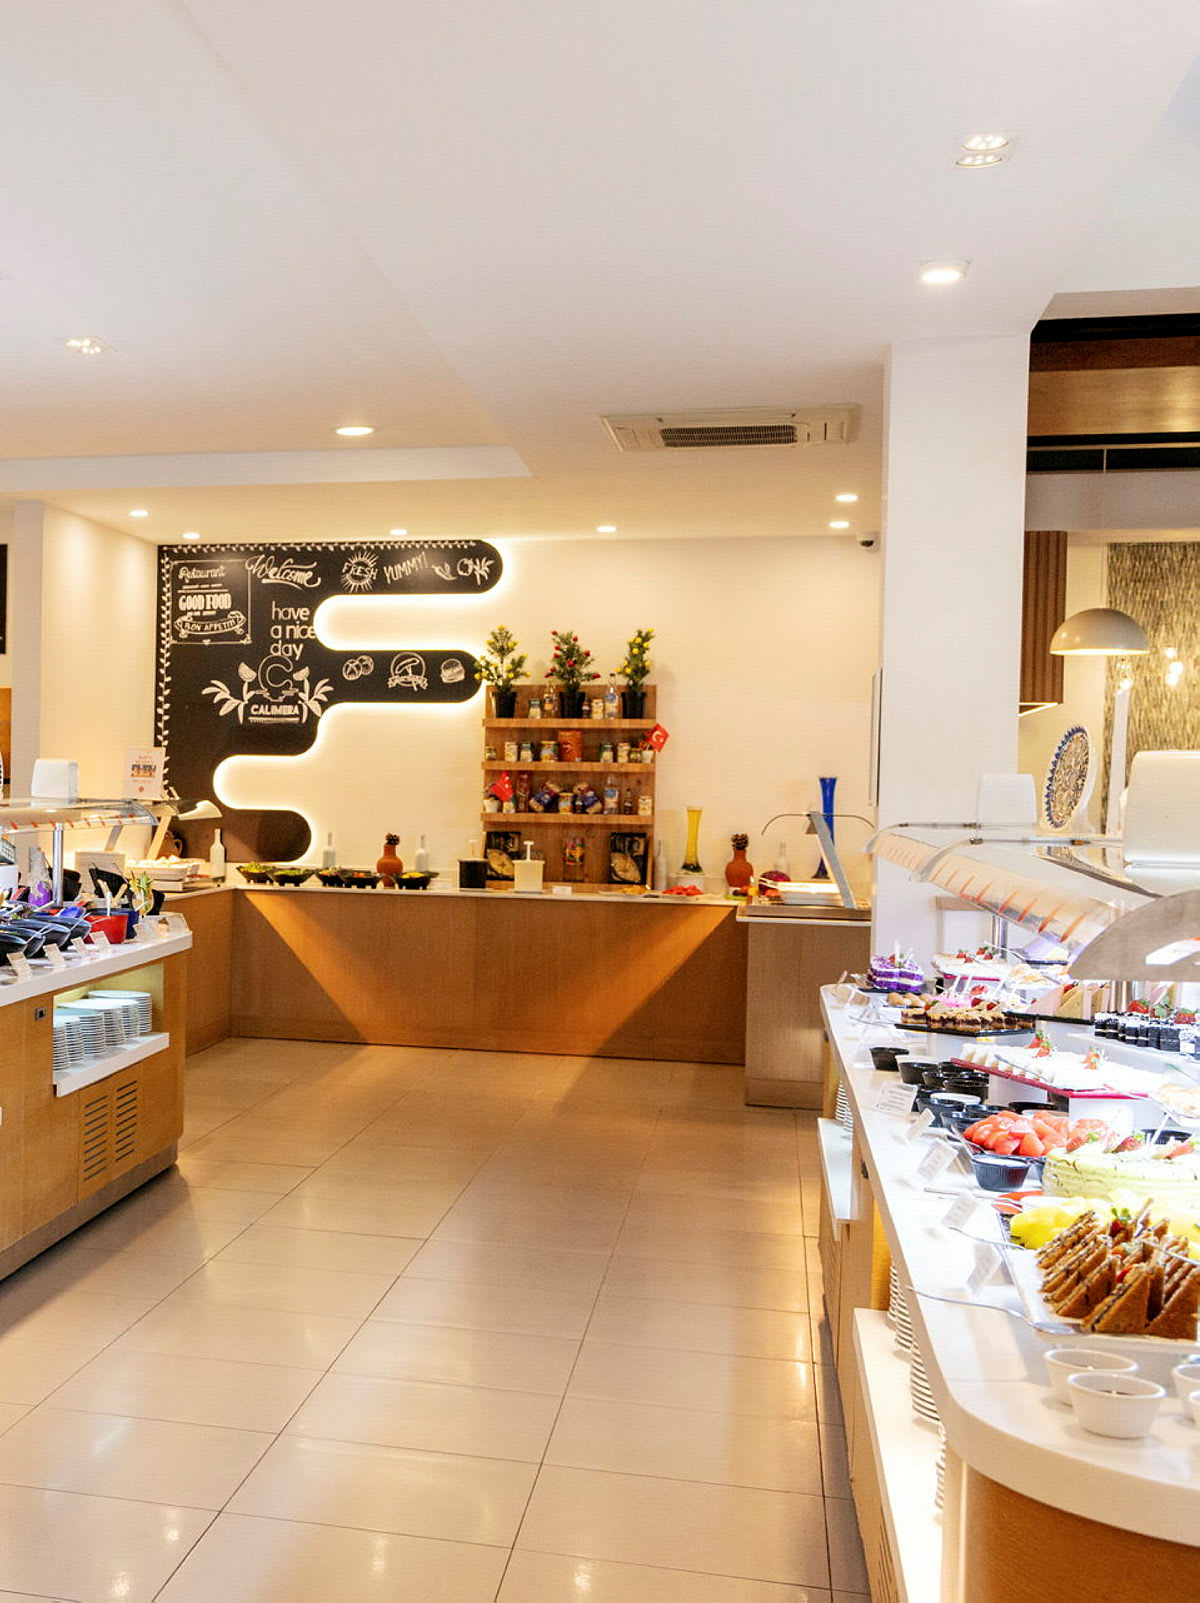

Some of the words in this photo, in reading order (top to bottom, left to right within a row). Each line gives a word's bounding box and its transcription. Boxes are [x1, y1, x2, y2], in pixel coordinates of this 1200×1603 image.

[245, 554, 321, 588] Welcome
[342, 562, 378, 580] FRESH
[383, 551, 430, 585] YUMMY!
[179, 594, 205, 611] GOOD
[205, 593, 232, 610] FOOD
[271, 601, 310, 620] have
[270, 625, 282, 639] a
[286, 621, 316, 639] nice
[270, 640, 303, 660] day
[250, 704, 300, 715] CALIMERA
